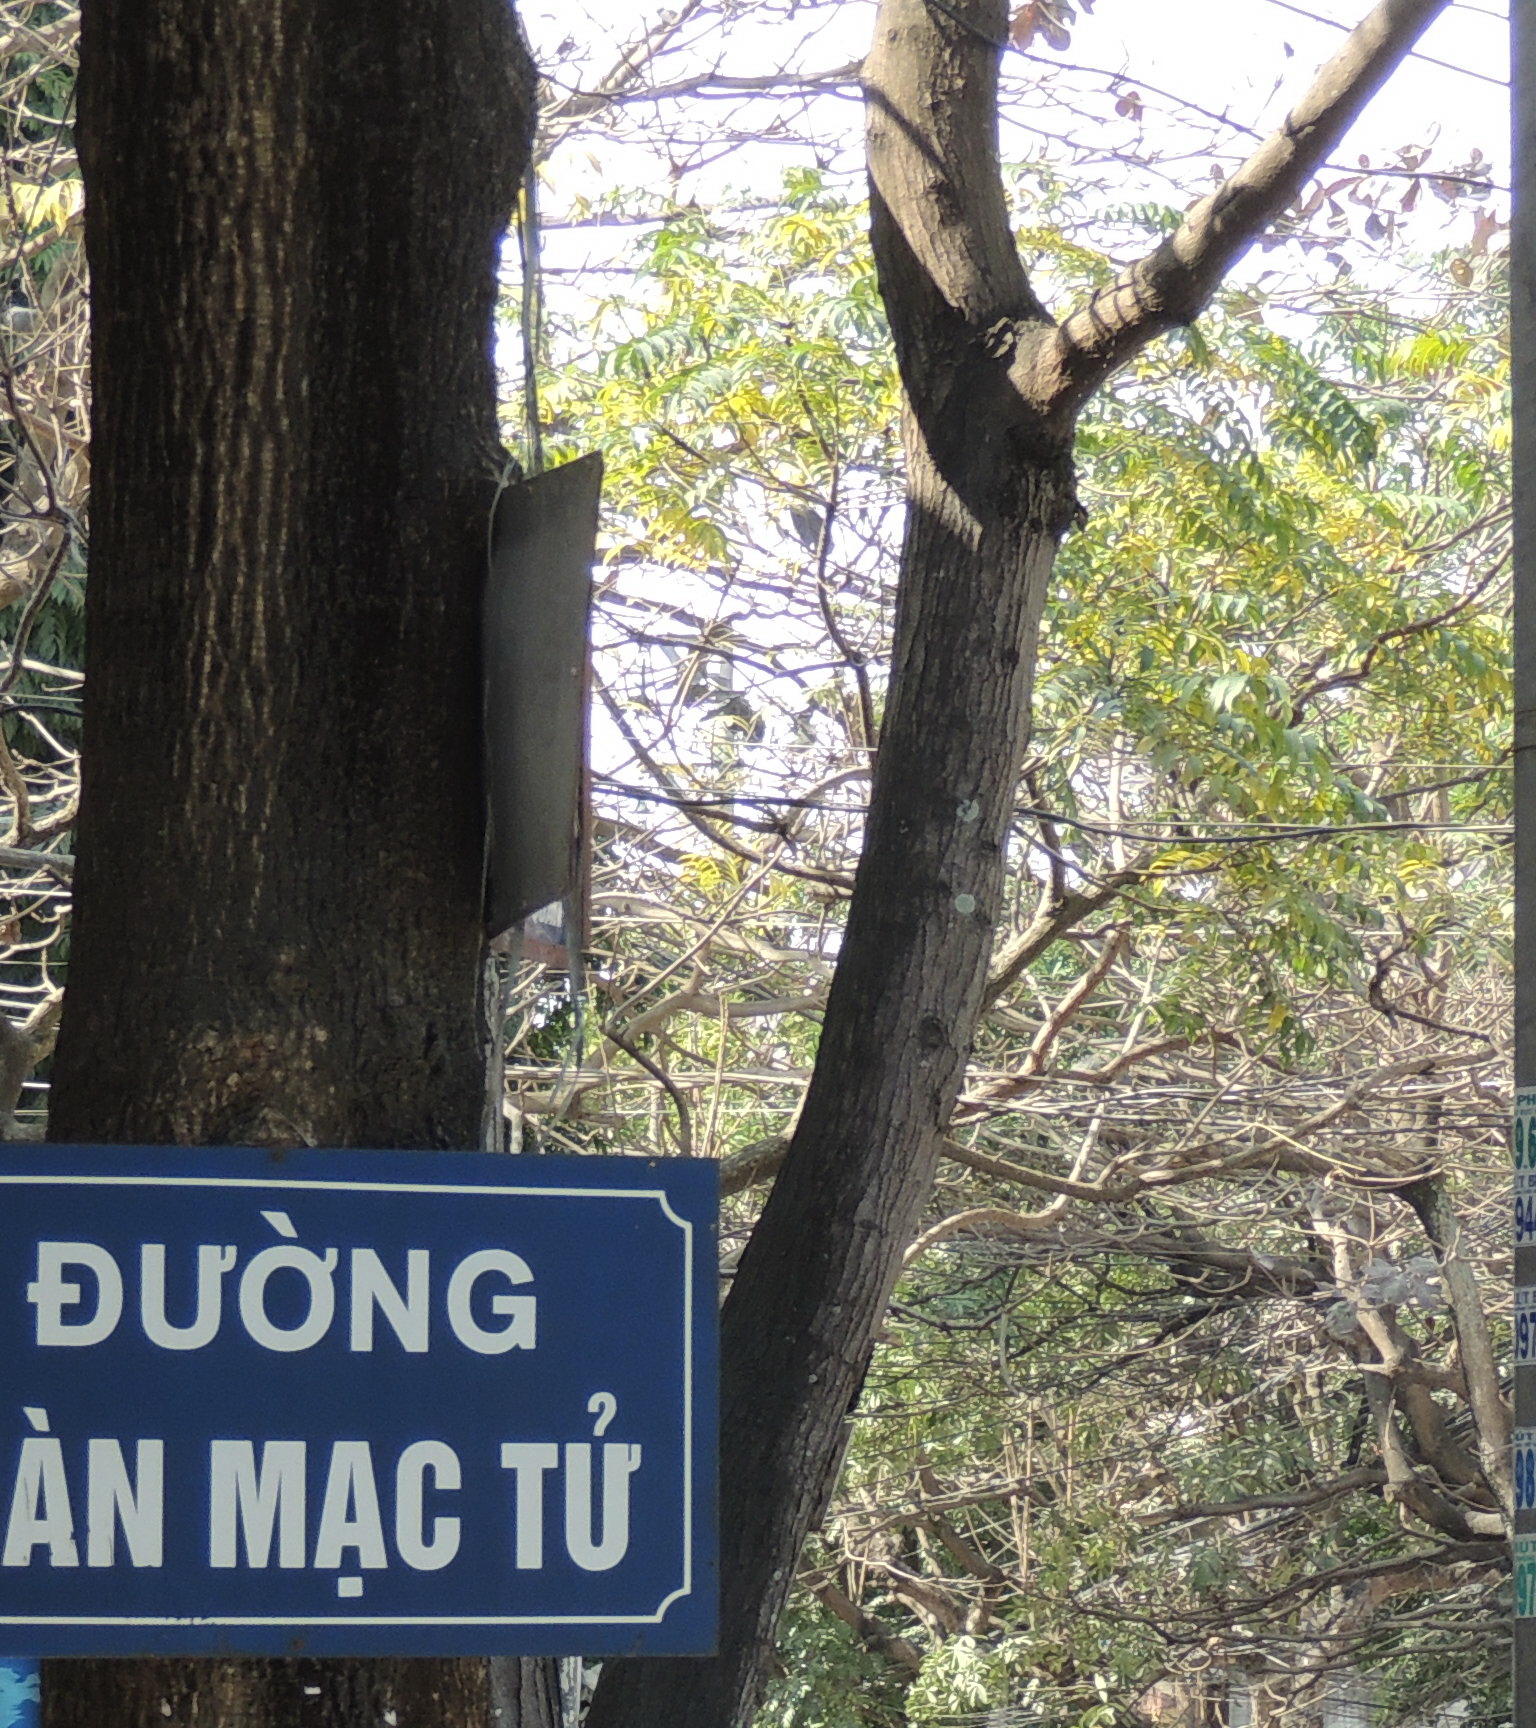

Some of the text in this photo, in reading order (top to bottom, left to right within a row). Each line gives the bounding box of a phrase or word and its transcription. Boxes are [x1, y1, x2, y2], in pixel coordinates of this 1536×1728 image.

[26, 1210, 538, 1355] ĐƯỜNG
[208, 1438, 463, 1599] MẠC
[500, 1391, 642, 1572] TỬ
